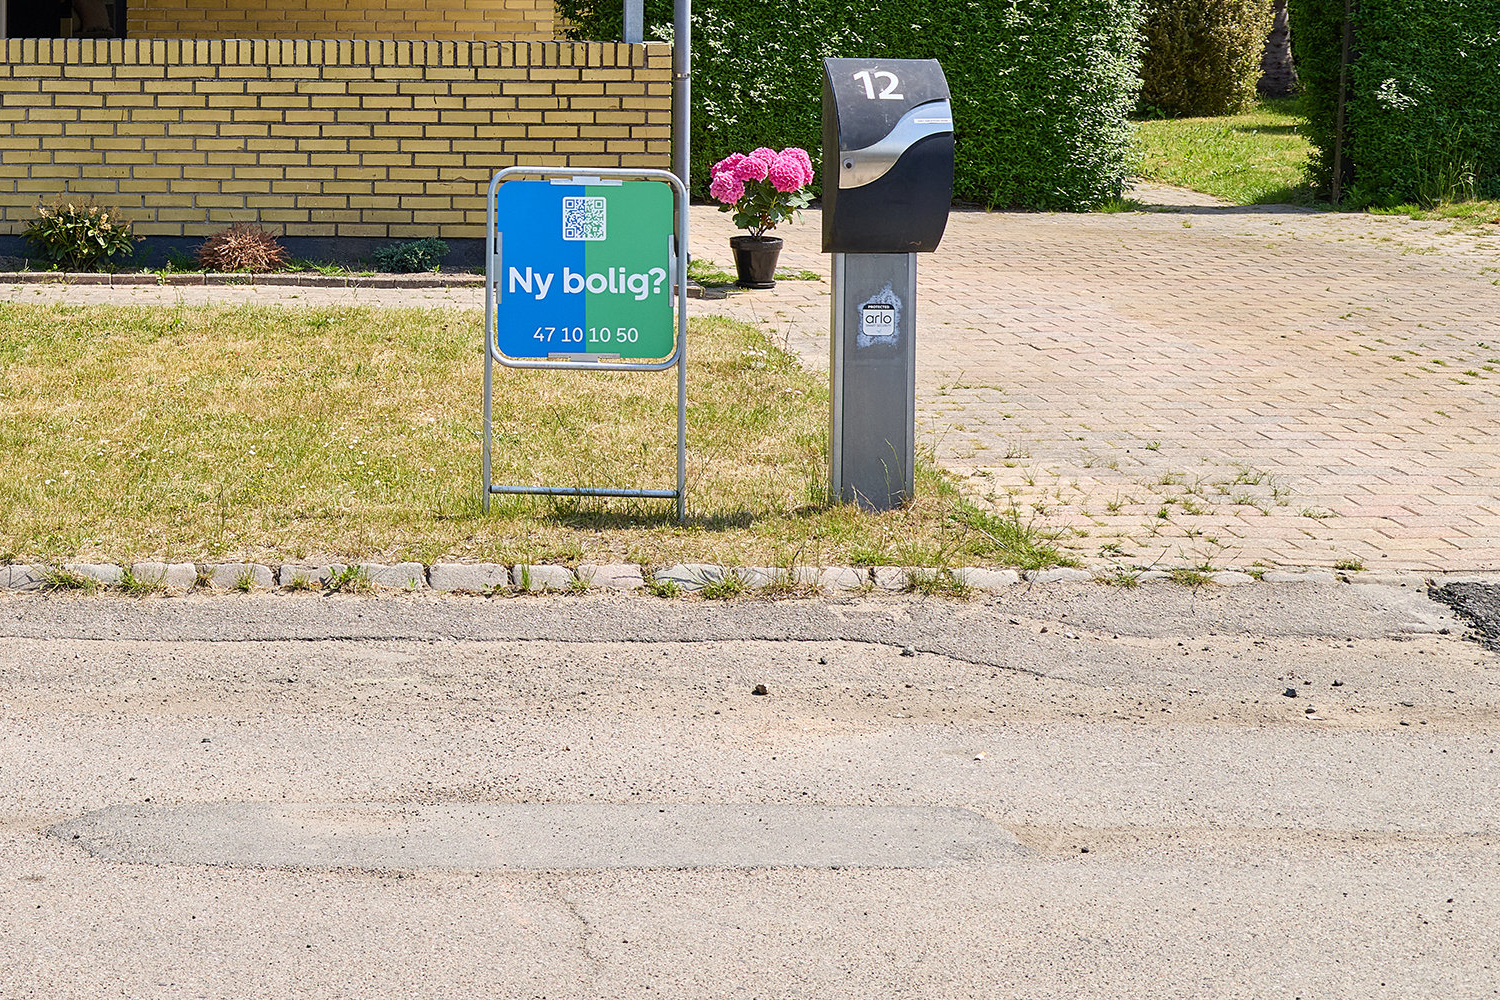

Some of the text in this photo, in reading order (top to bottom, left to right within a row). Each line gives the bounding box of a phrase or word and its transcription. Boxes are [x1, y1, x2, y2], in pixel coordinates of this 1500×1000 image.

[853, 70, 904, 100] 12
[508, 266, 666, 301] Ny bolig?
[865, 311, 892, 324] arlo
[533, 327, 638, 343] 47 10 10 50
